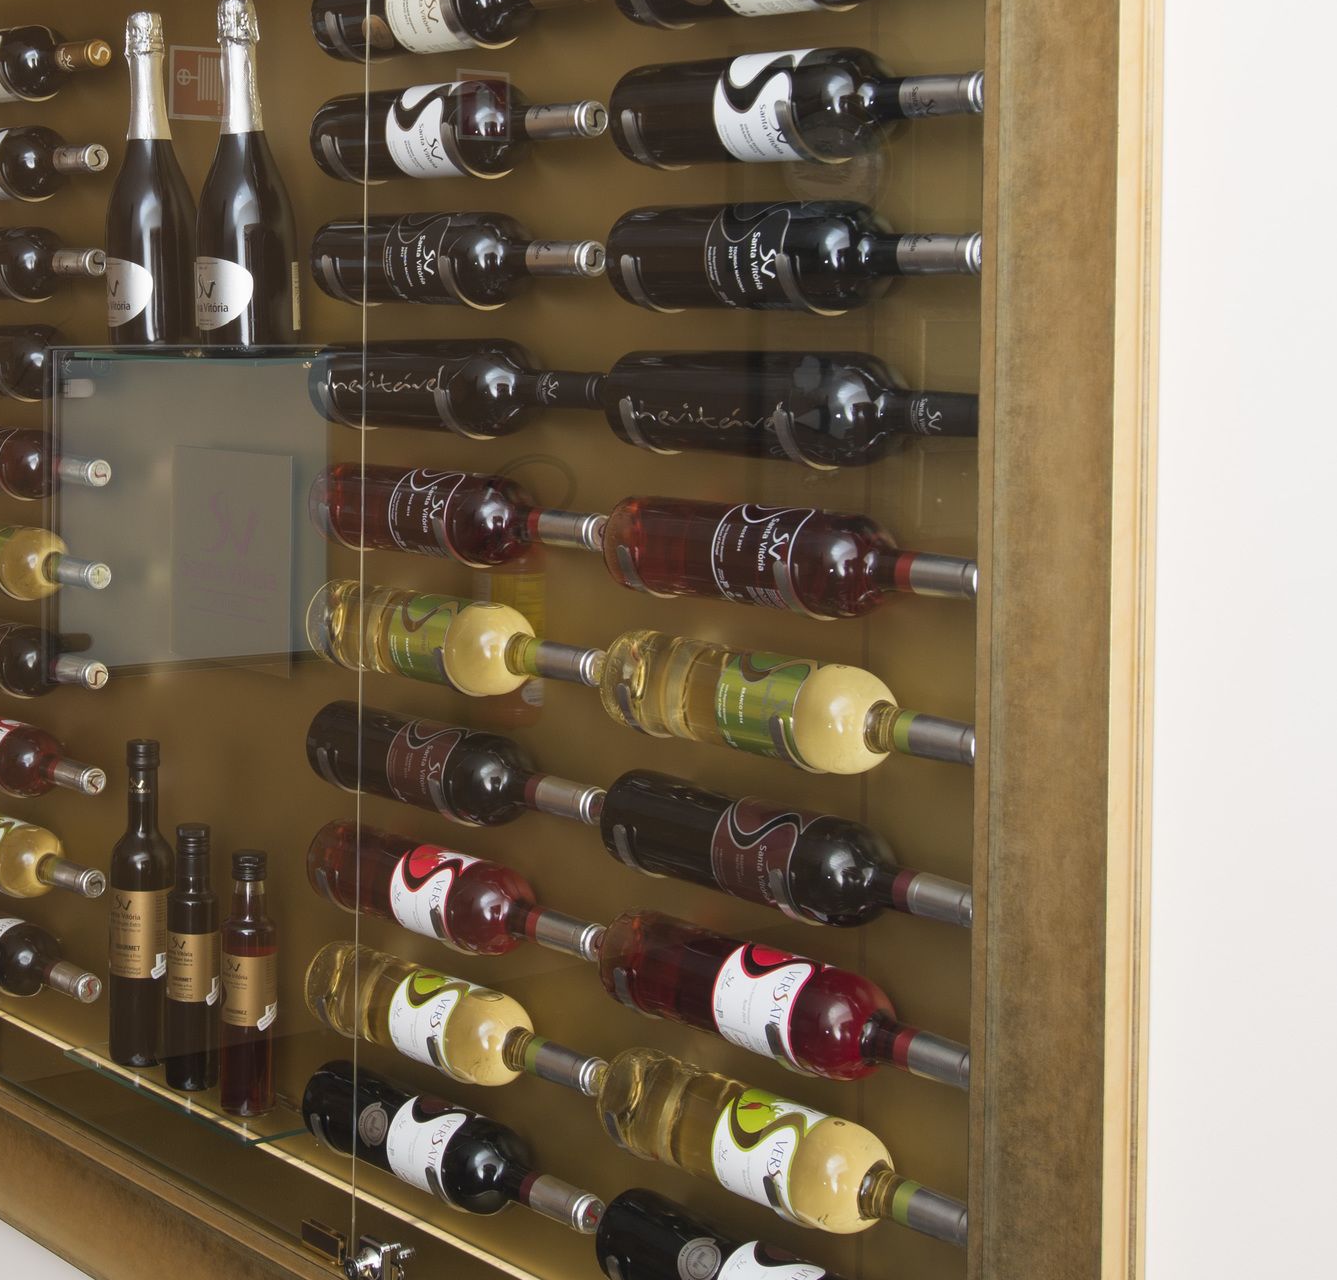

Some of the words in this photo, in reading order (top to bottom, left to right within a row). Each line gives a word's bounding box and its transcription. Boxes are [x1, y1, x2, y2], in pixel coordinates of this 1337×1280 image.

[415, 234, 426, 258] Santa
[749, 231, 762, 259] Santa
[415, 260, 427, 285] Vitória
[750, 260, 764, 290] Vitória
[203, 302, 229, 314] Vitória
[424, 485, 439, 506] Santa
[422, 507, 430, 533] Vitória
[761, 517, 781, 540] Santa
[757, 542, 769, 572] Vitória
[756, 844, 768, 872] Santa
